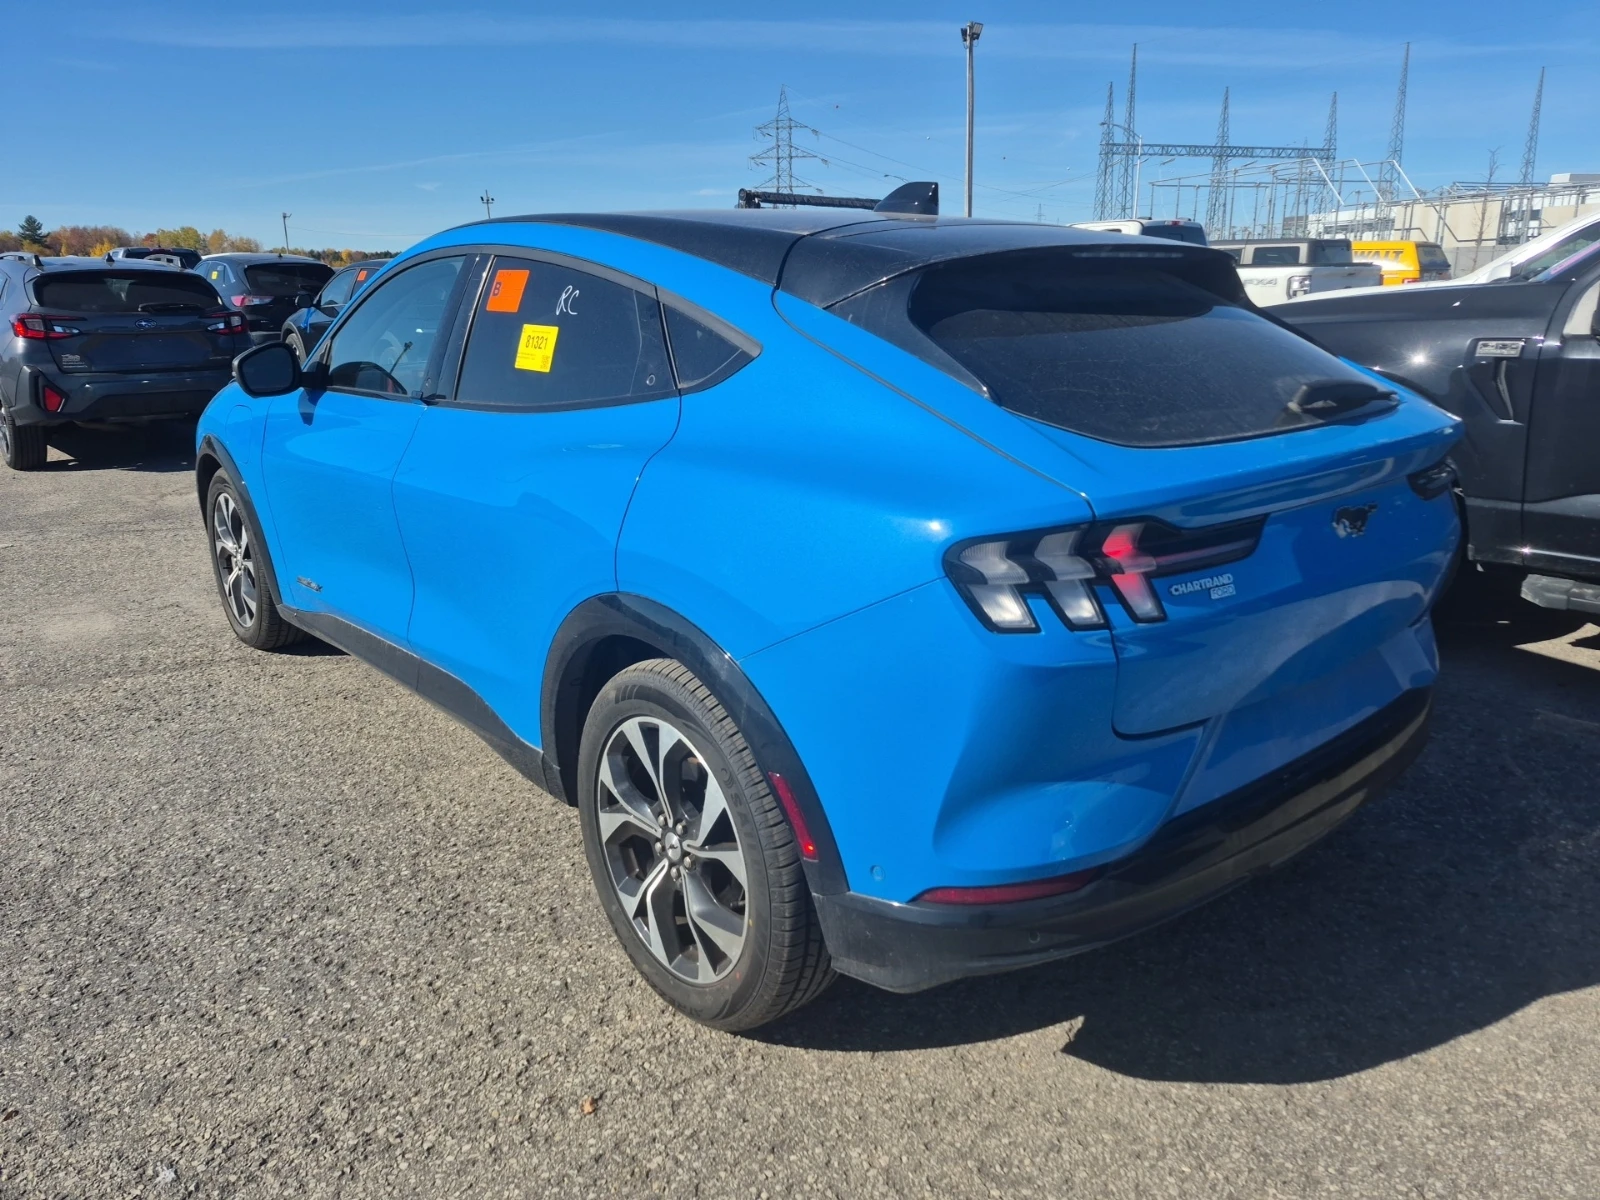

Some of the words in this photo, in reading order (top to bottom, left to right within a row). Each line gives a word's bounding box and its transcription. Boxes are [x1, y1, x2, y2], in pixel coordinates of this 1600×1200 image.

[555, 285, 580, 316] RC
[525, 334, 549, 349] 81321
[1170, 573, 1234, 595] CHARTRAND
